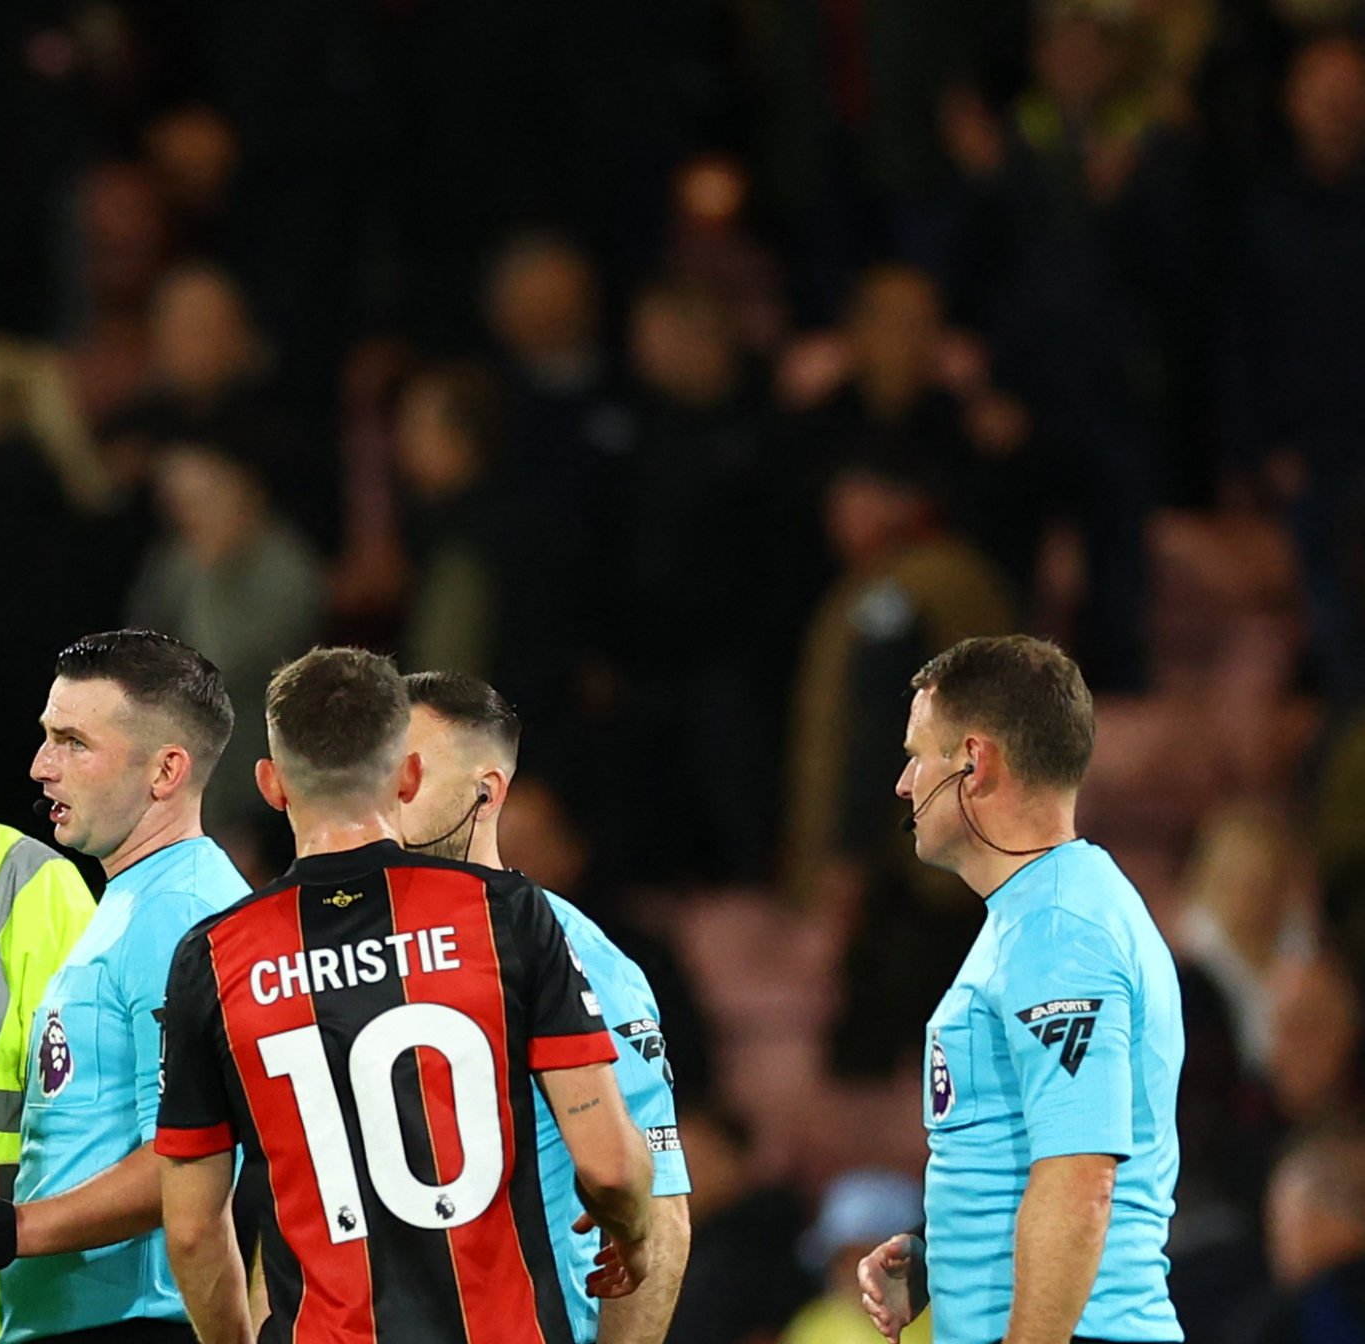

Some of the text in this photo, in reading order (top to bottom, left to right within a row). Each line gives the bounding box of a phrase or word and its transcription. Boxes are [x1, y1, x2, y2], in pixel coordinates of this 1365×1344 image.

[250, 926, 461, 1005] CHRISTIE
[1047, 1001, 1091, 1014] SPORTS
[256, 1002, 505, 1245] 10
